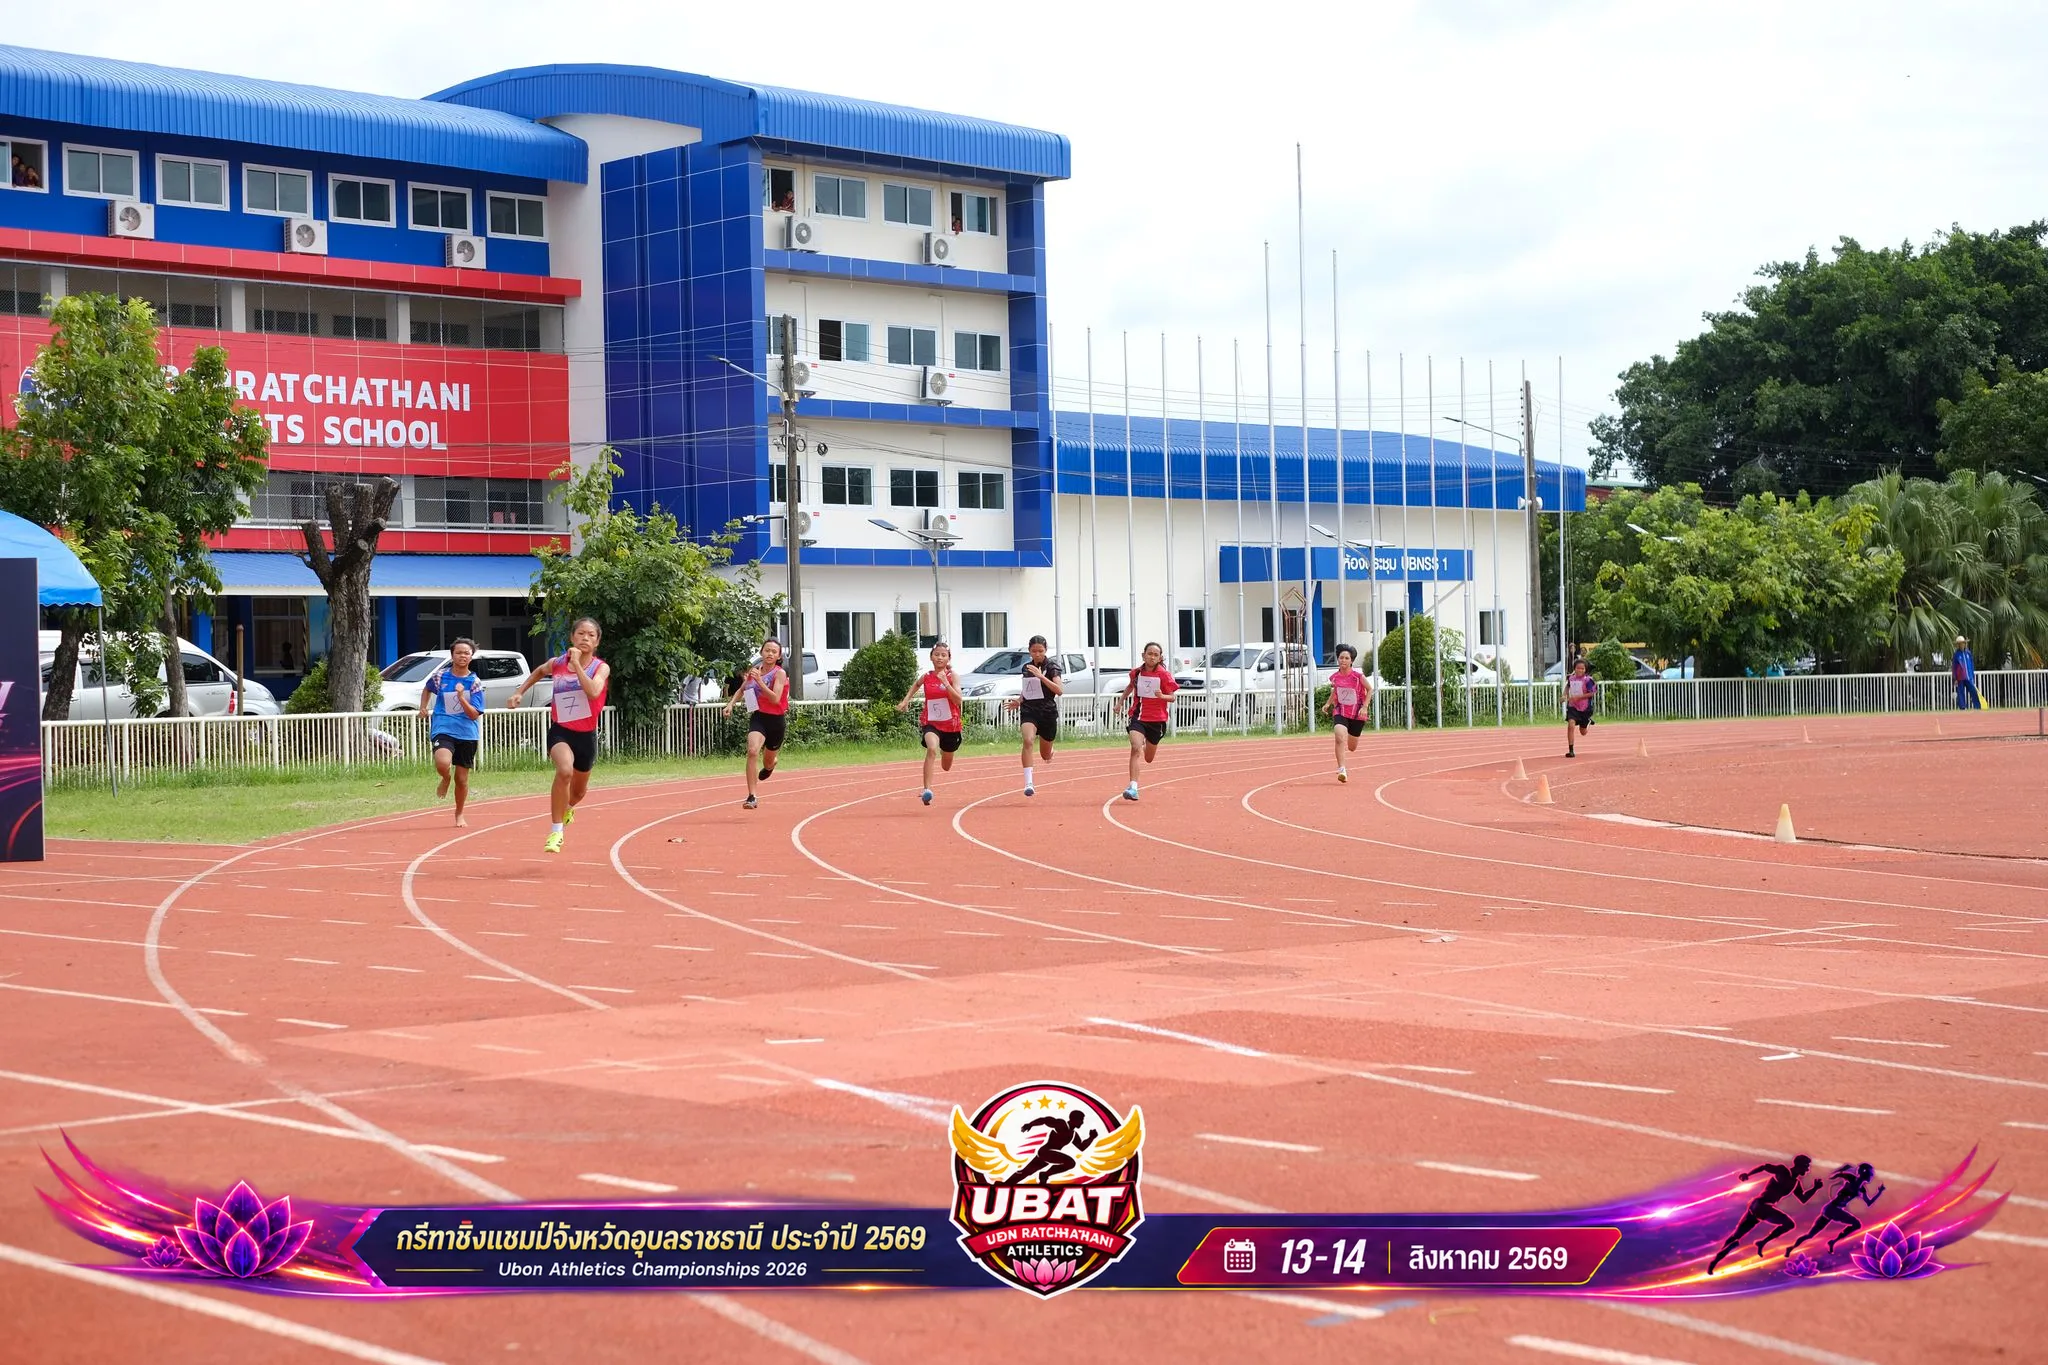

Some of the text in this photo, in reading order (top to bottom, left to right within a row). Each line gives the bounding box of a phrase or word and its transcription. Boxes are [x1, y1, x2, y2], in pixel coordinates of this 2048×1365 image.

[323, 415, 448, 451] SCHOOL
[1442, 557, 1448, 571] 1
[1025, 680, 1038, 697] 4
[1144, 680, 1152, 695] 3
[1341, 690, 1351, 701] 2
[562, 696, 579, 716] 7
[933, 703, 943, 719] 5
